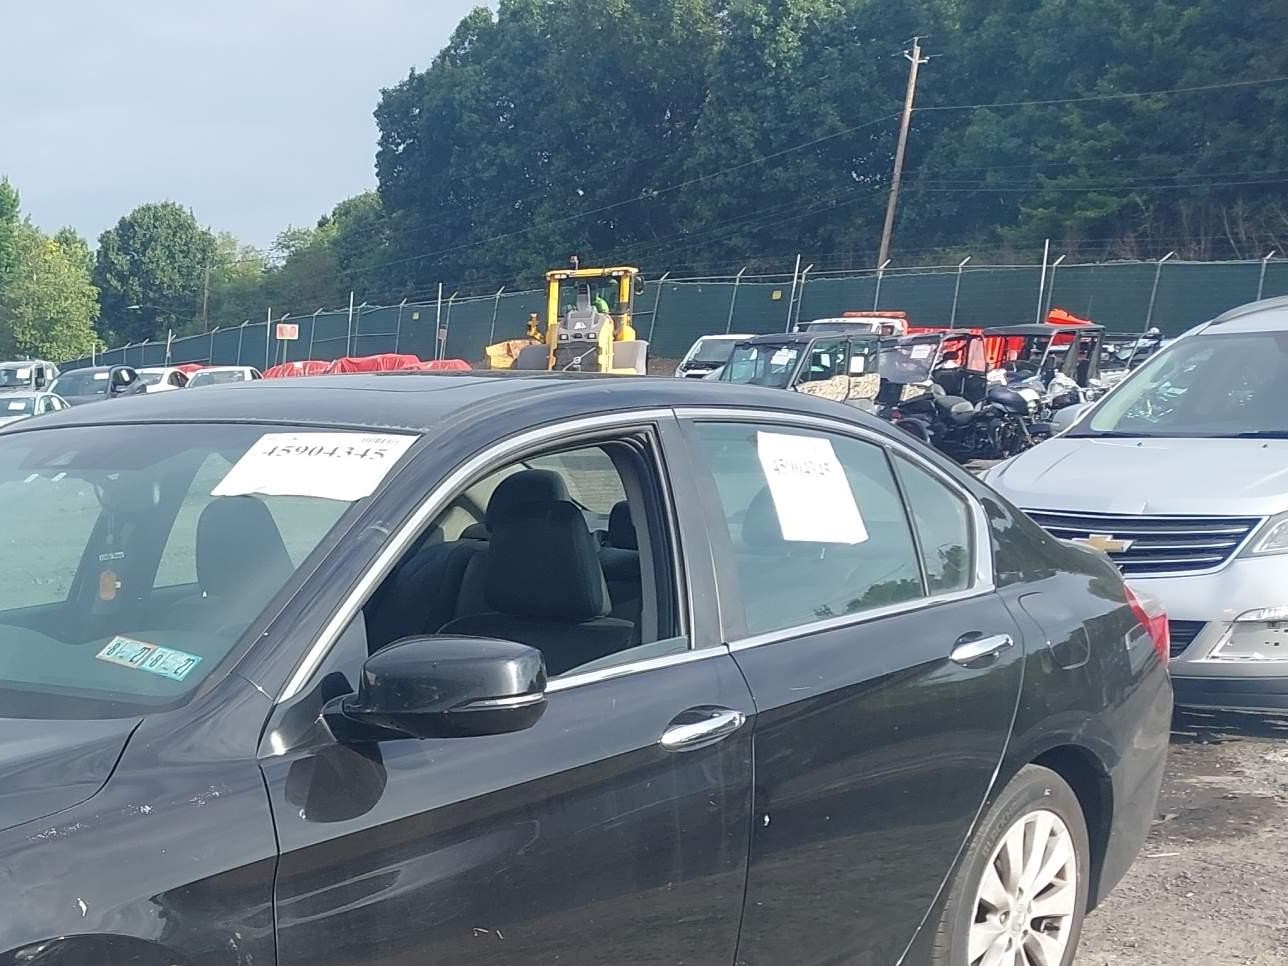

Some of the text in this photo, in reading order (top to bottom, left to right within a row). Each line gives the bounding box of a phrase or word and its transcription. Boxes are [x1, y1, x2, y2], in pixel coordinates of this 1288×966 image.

[263, 445, 389, 460] 45904345
[106, 642, 121, 656] 8
[149, 654, 164, 668] 8
